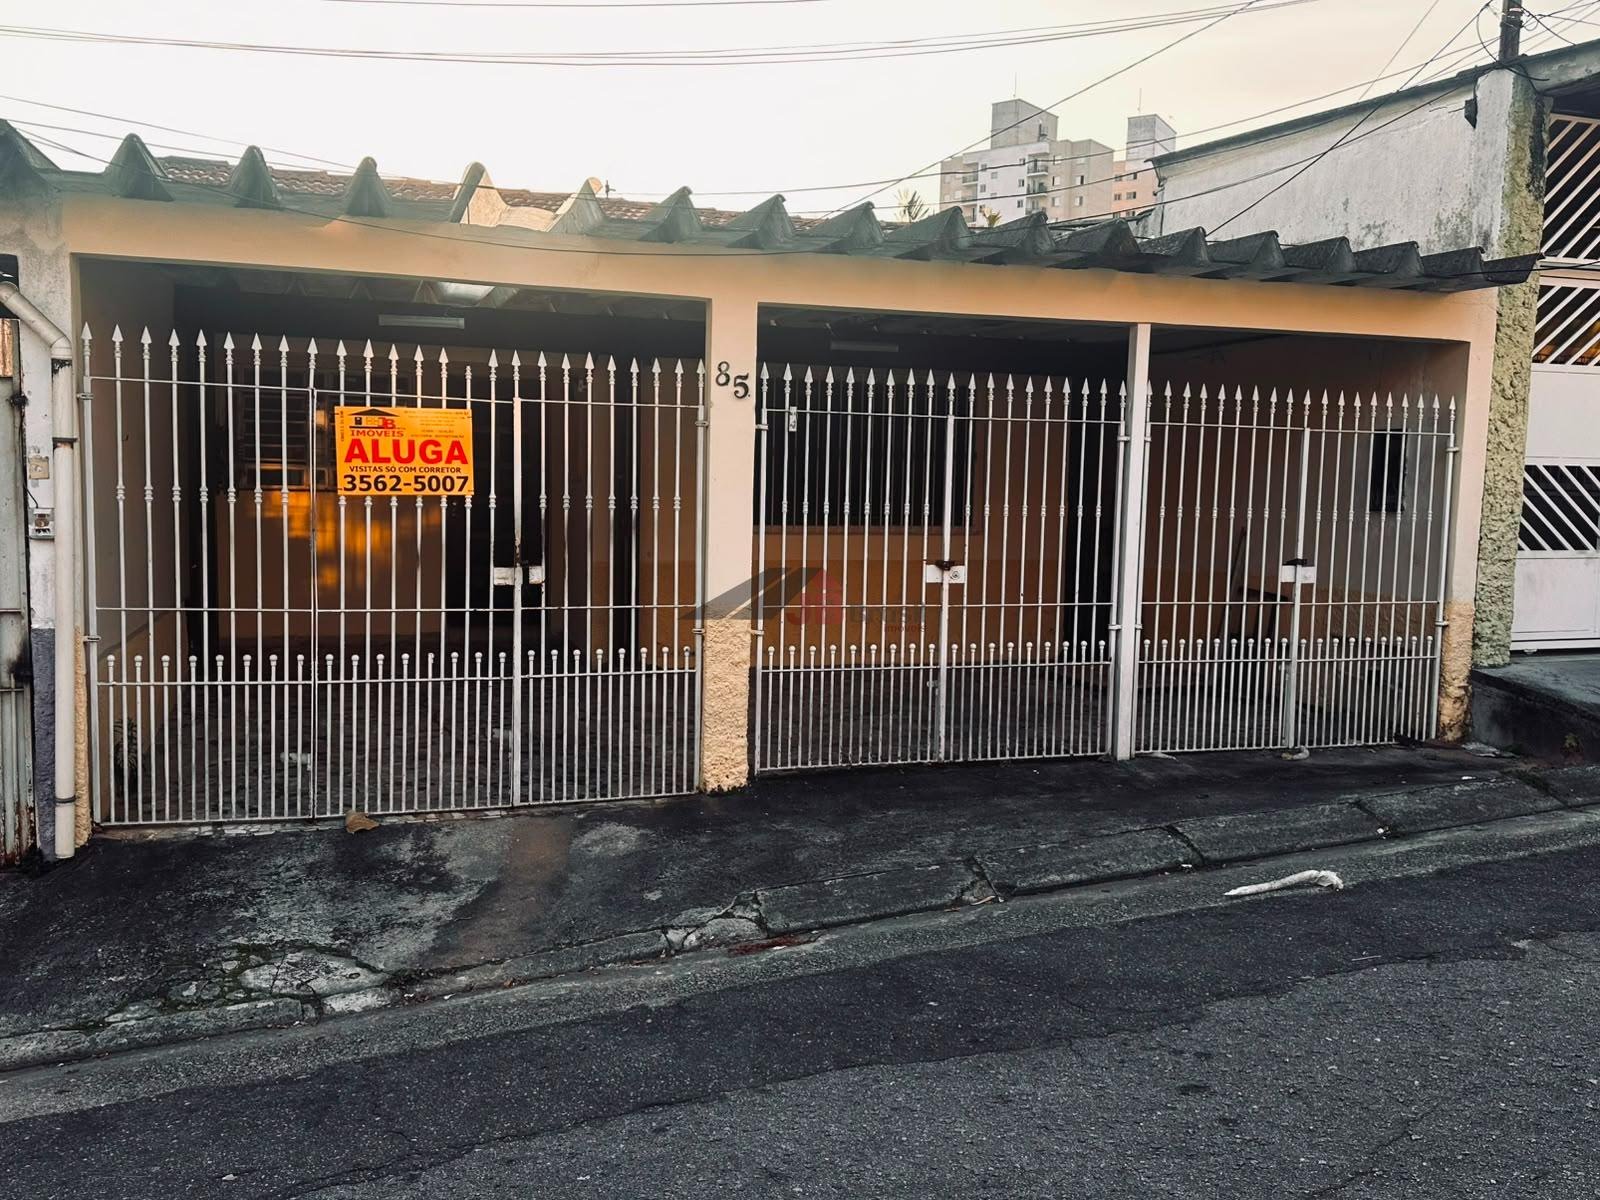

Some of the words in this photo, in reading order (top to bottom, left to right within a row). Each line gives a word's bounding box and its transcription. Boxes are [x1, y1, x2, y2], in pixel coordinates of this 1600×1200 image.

[715, 360, 750, 399] 85
[344, 438, 469, 465] ALUGA
[418, 466, 461, 474] CORRETOR
[343, 475, 469, 492] 3562-5007
